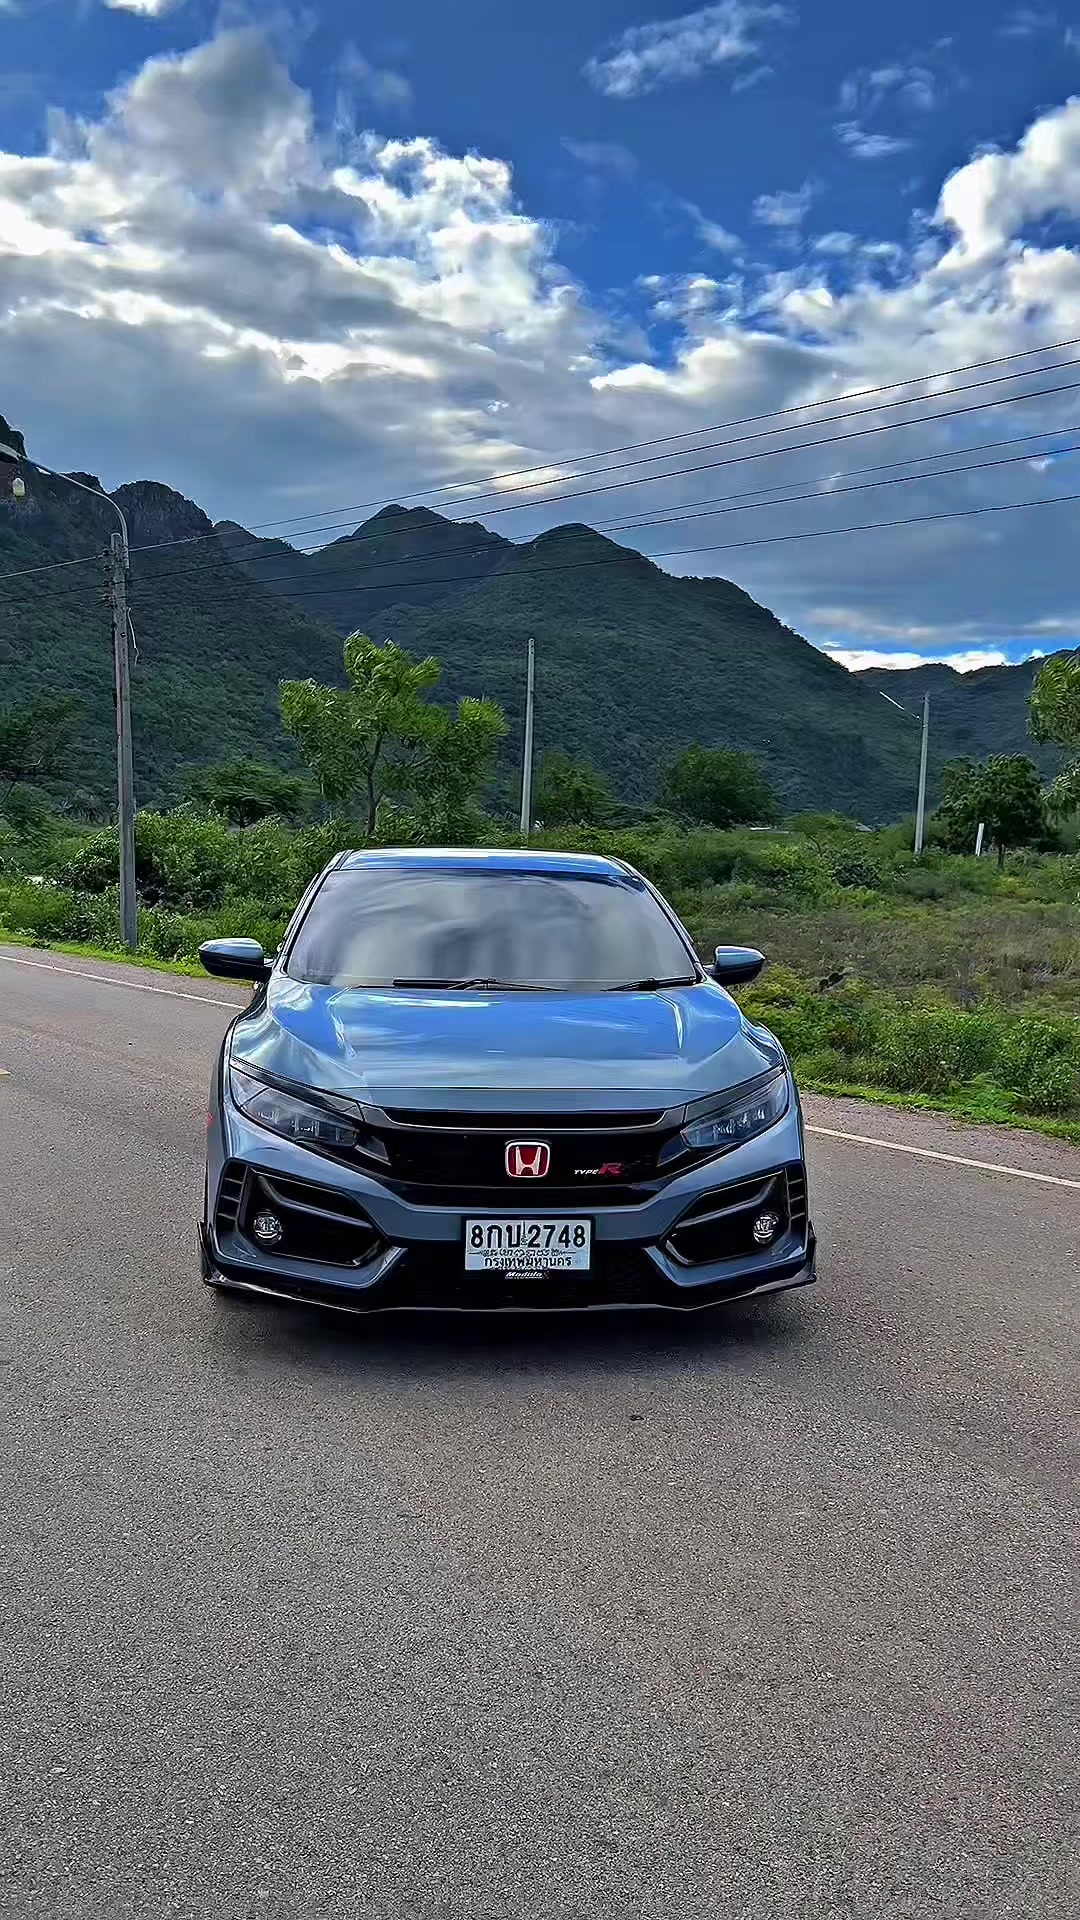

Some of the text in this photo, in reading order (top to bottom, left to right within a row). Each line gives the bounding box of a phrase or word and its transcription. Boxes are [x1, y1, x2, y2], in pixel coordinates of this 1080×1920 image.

[527, 1224, 586, 1248] 2748
[484, 1256, 572, 1268] กรงเทพมหานคร
